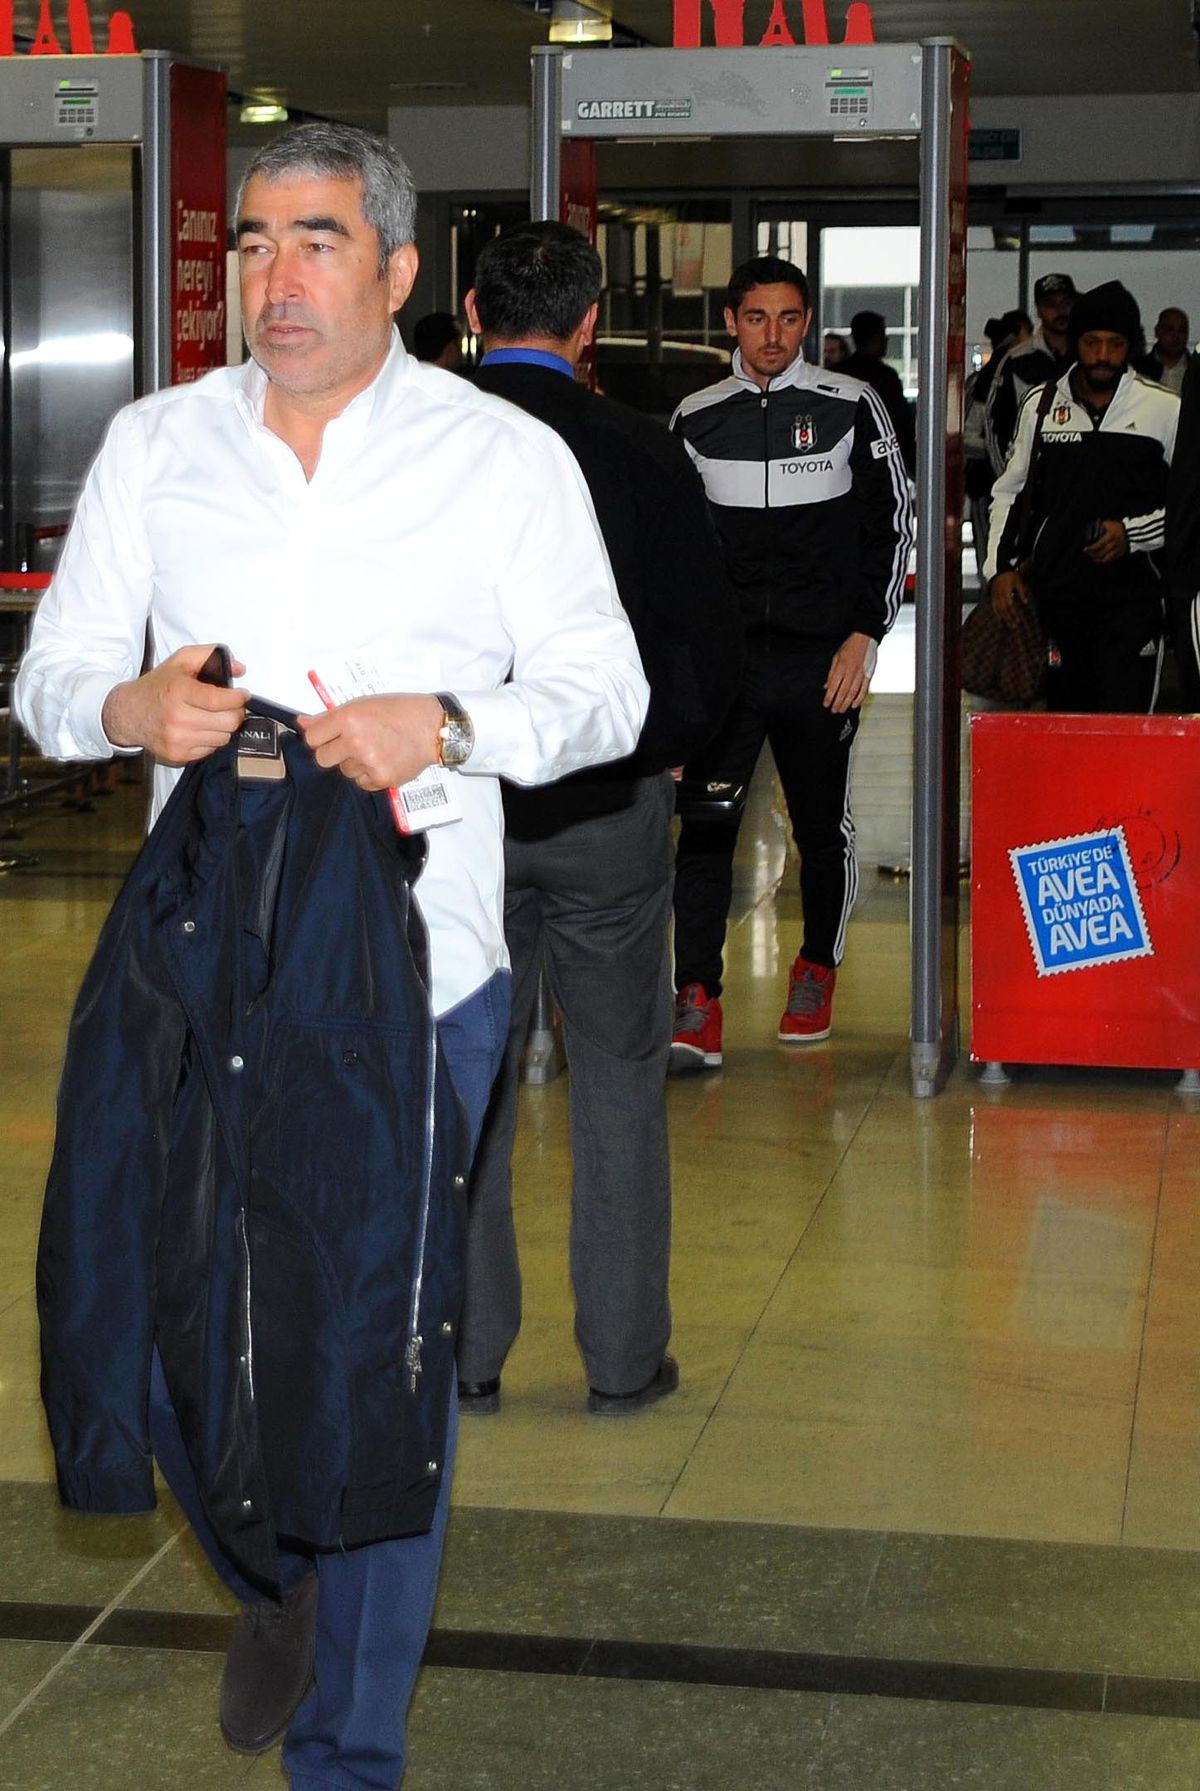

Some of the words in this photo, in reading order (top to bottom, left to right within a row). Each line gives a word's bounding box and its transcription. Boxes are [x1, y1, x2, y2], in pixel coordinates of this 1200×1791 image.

[578, 101, 655, 118] GARRETT
[1041, 432, 1082, 443] TOYOTA
[780, 460, 834, 474] TOYOTA
[1037, 862, 1121, 907] AVEA
[1041, 893, 1125, 925] DÜNYADA
[1050, 911, 1134, 956] AVEA
